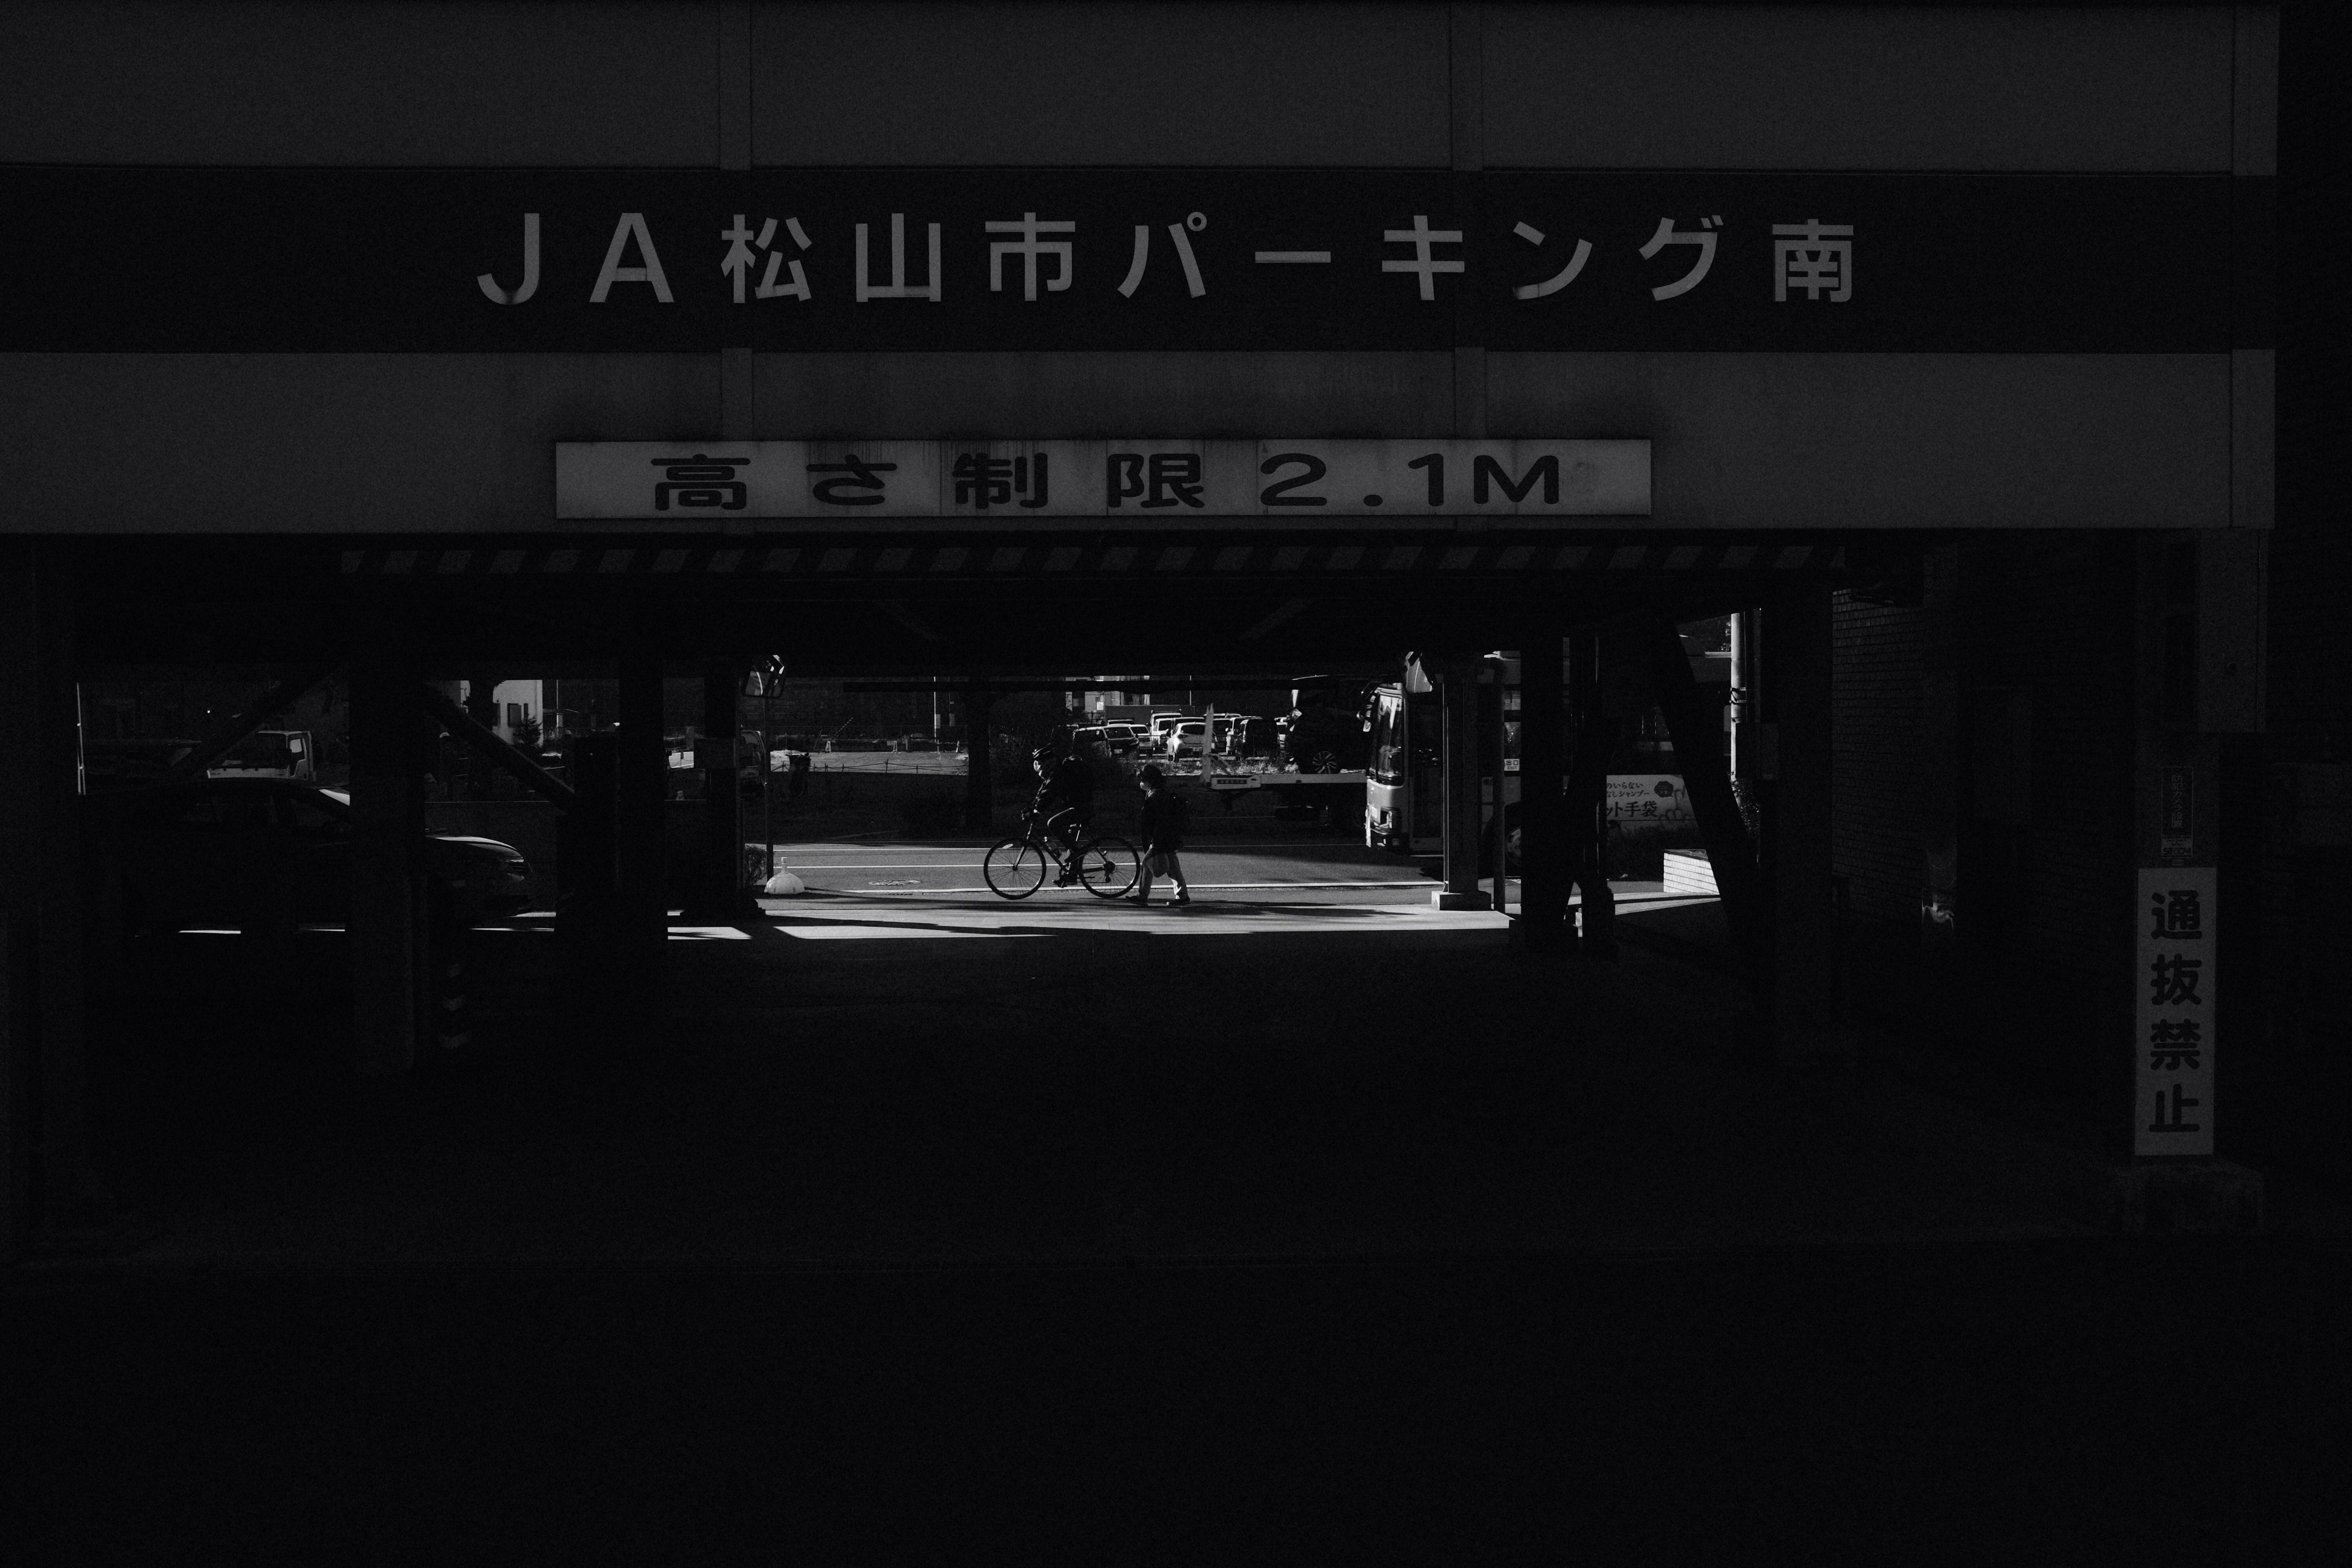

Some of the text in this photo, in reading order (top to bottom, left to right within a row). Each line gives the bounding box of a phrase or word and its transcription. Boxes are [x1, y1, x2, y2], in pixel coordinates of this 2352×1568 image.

[477, 211, 1854, 305] JA松山市パーキング南
[651, 452, 1559, 510] 高さ制限2.1M
[2171, 774, 2184, 828] 防犯カメラ設置
[2149, 890, 2202, 1133] 通抜禁止
